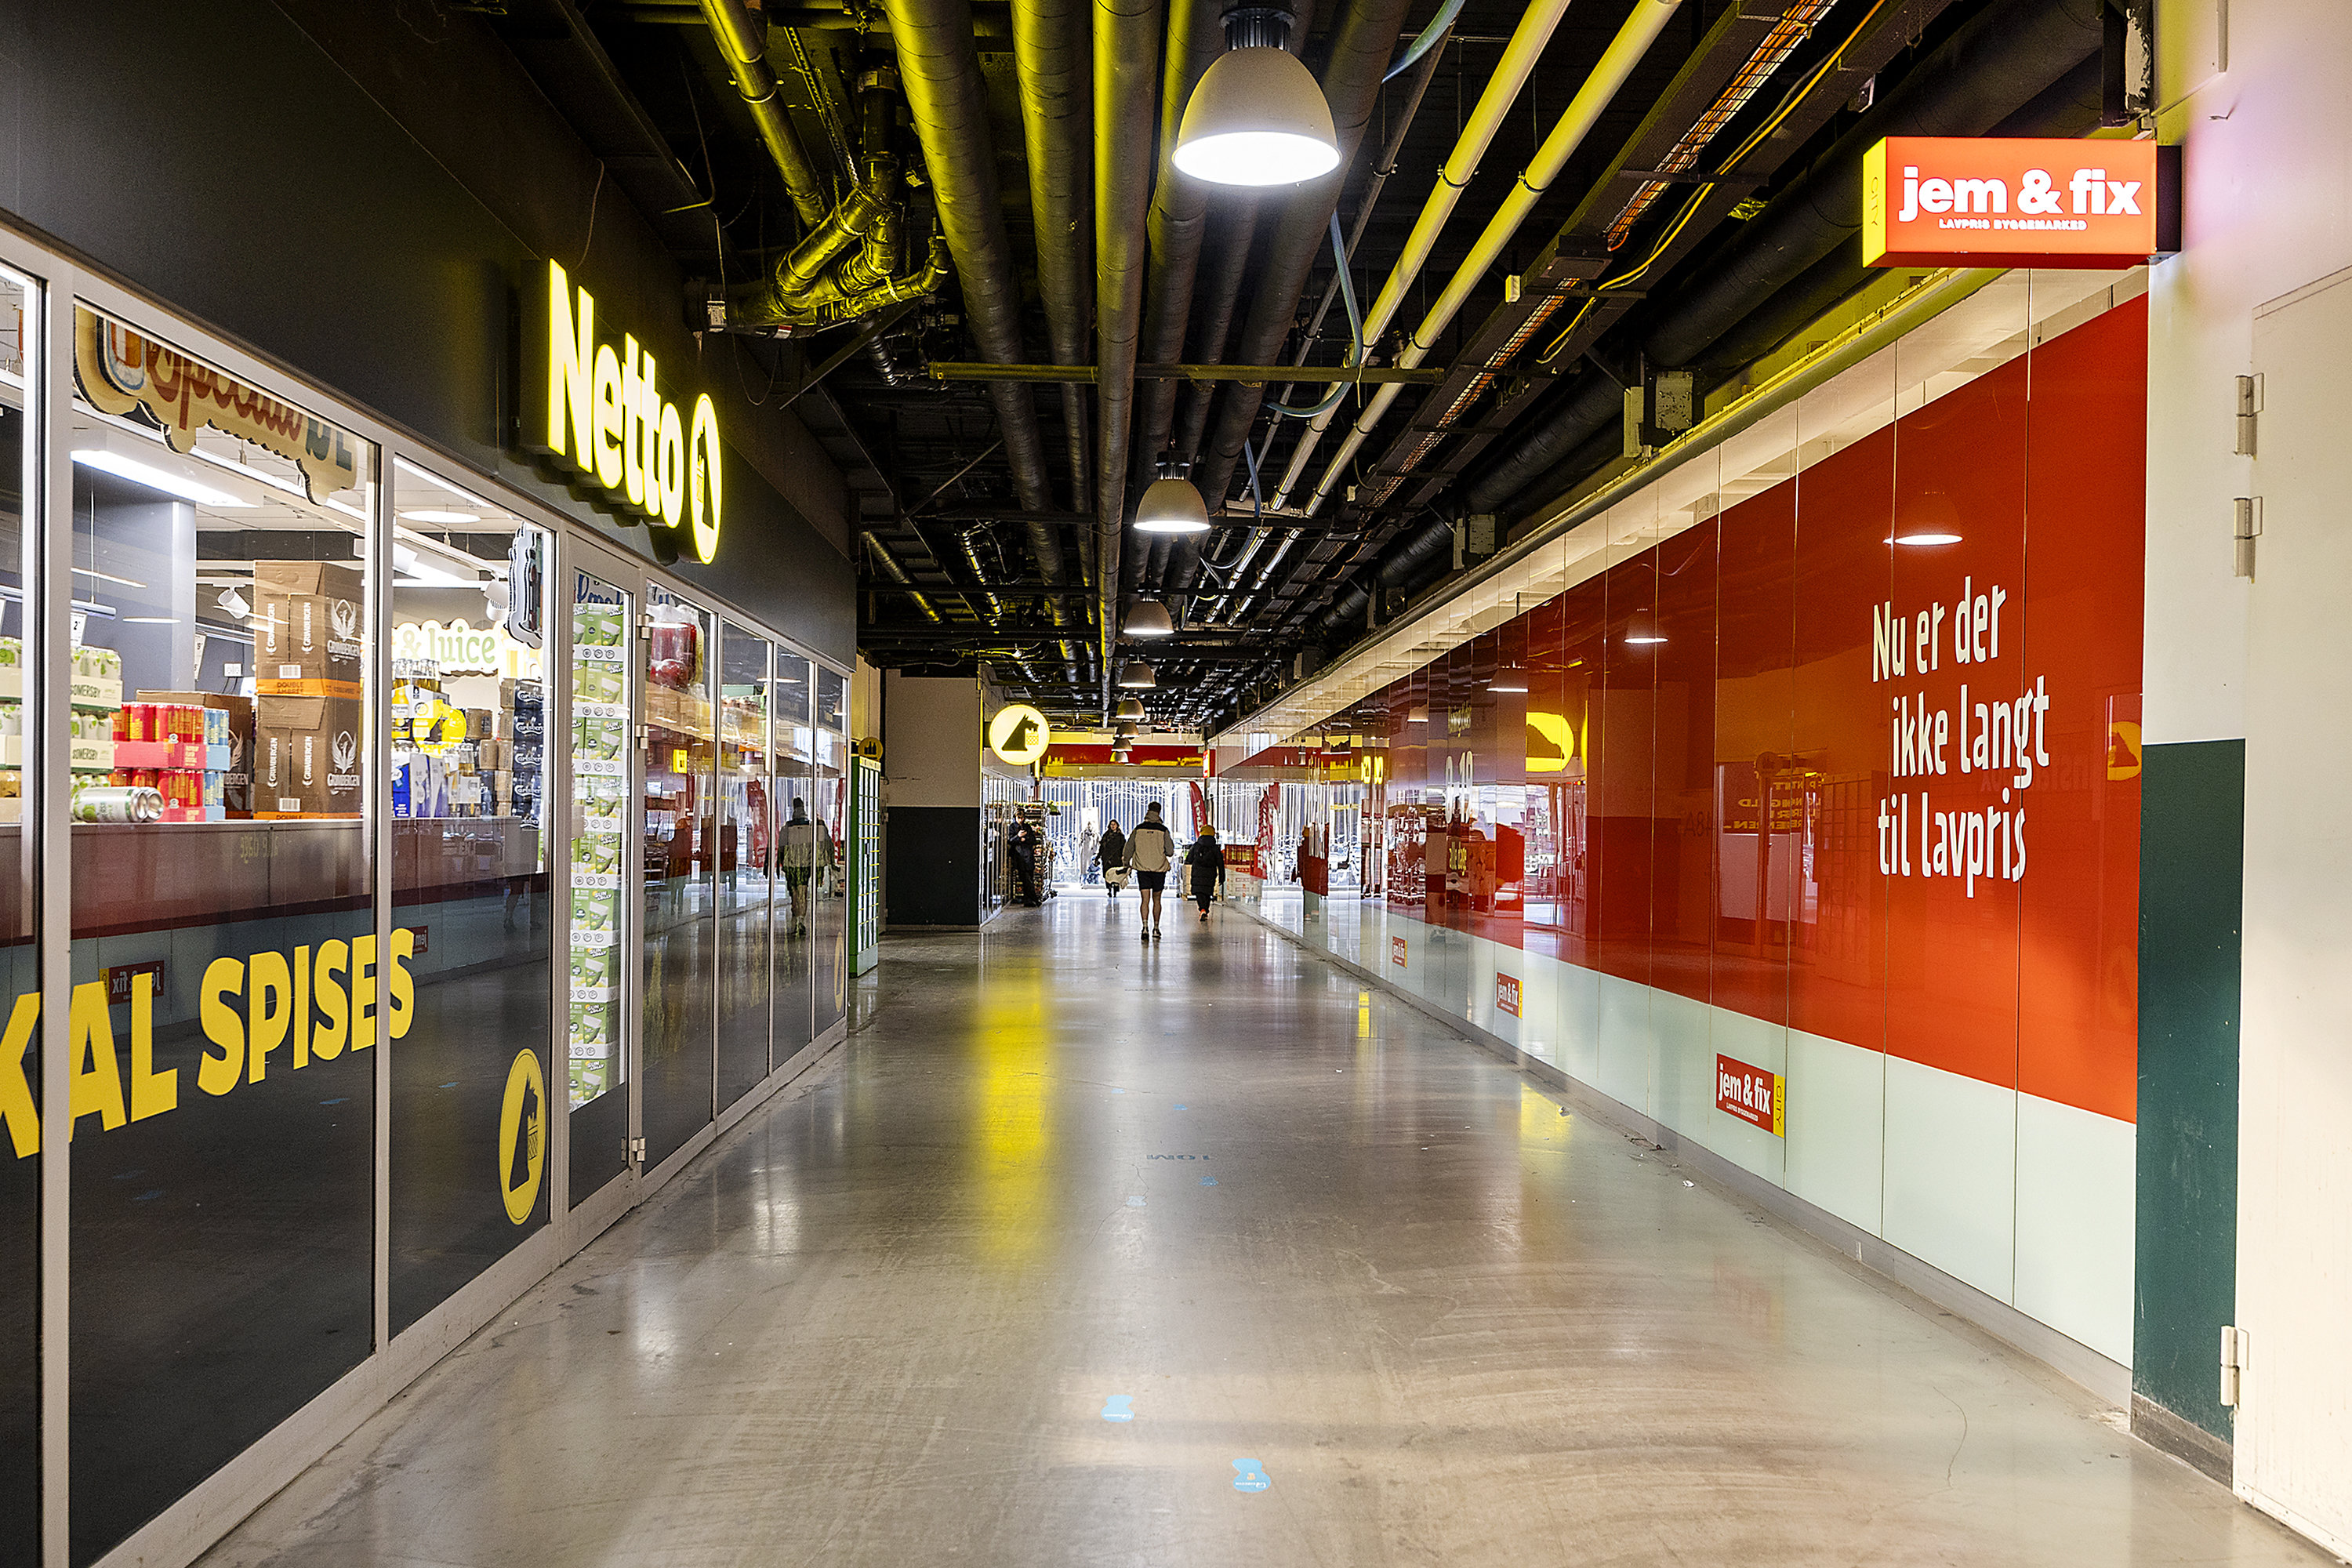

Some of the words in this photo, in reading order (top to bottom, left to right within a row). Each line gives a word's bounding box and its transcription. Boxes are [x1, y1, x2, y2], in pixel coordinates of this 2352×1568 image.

[1870, 176, 1880, 227] CITY
[1898, 165, 2009, 223] jem
[2016, 168, 2064, 216] &
[2069, 168, 2143, 216] fix
[1939, 217, 1991, 230] LAVPRIS
[1994, 218, 2088, 231] BYGGEMARKED
[548, 257, 684, 529] Netto
[428, 626, 496, 664] Juice
[1872, 601, 1906, 683] Nu
[1915, 601, 1945, 674] er
[1955, 575, 2007, 665] der
[1892, 690, 1949, 777] ikke
[1959, 674, 2051, 789] langt
[1877, 792, 1911, 877] til
[1922, 787, 2027, 898] lavpris
[196, 927, 416, 1097] SPISES
[1718, 1062, 1742, 1102] jem
[1743, 1073, 1754, 1108] &
[1754, 1076, 1772, 1116] fix
